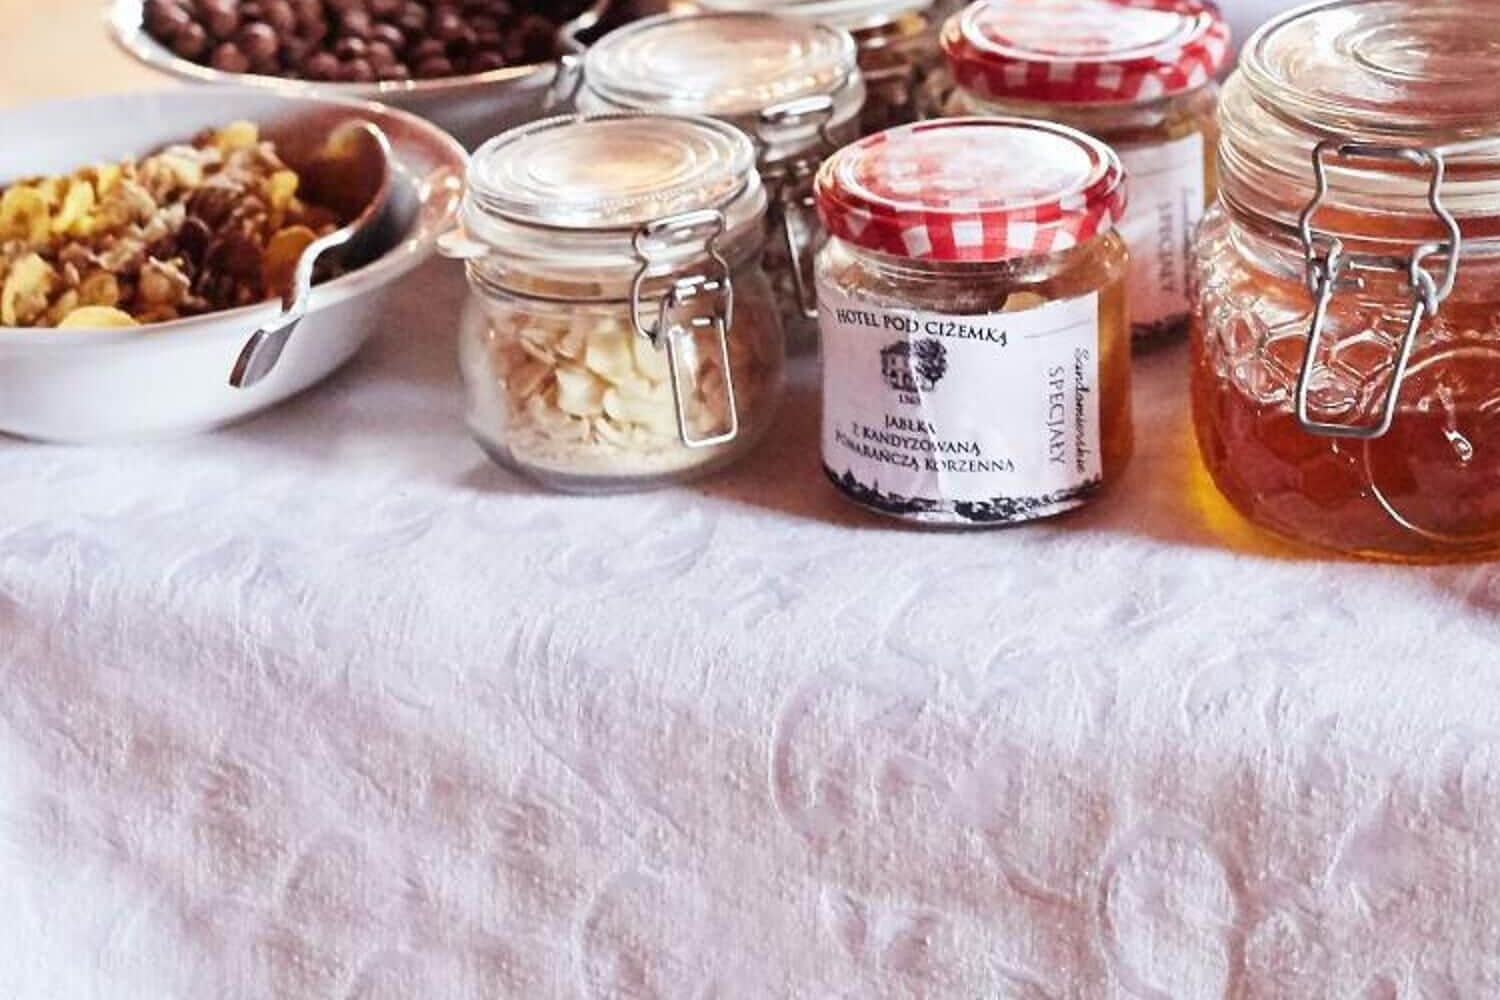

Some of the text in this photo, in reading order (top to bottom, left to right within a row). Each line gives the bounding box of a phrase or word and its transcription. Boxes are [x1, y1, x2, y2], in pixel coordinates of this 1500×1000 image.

[836, 308, 880, 329] HOTEL
[883, 314, 920, 334] POD
[1047, 365, 1066, 465] SPECJAŁY
